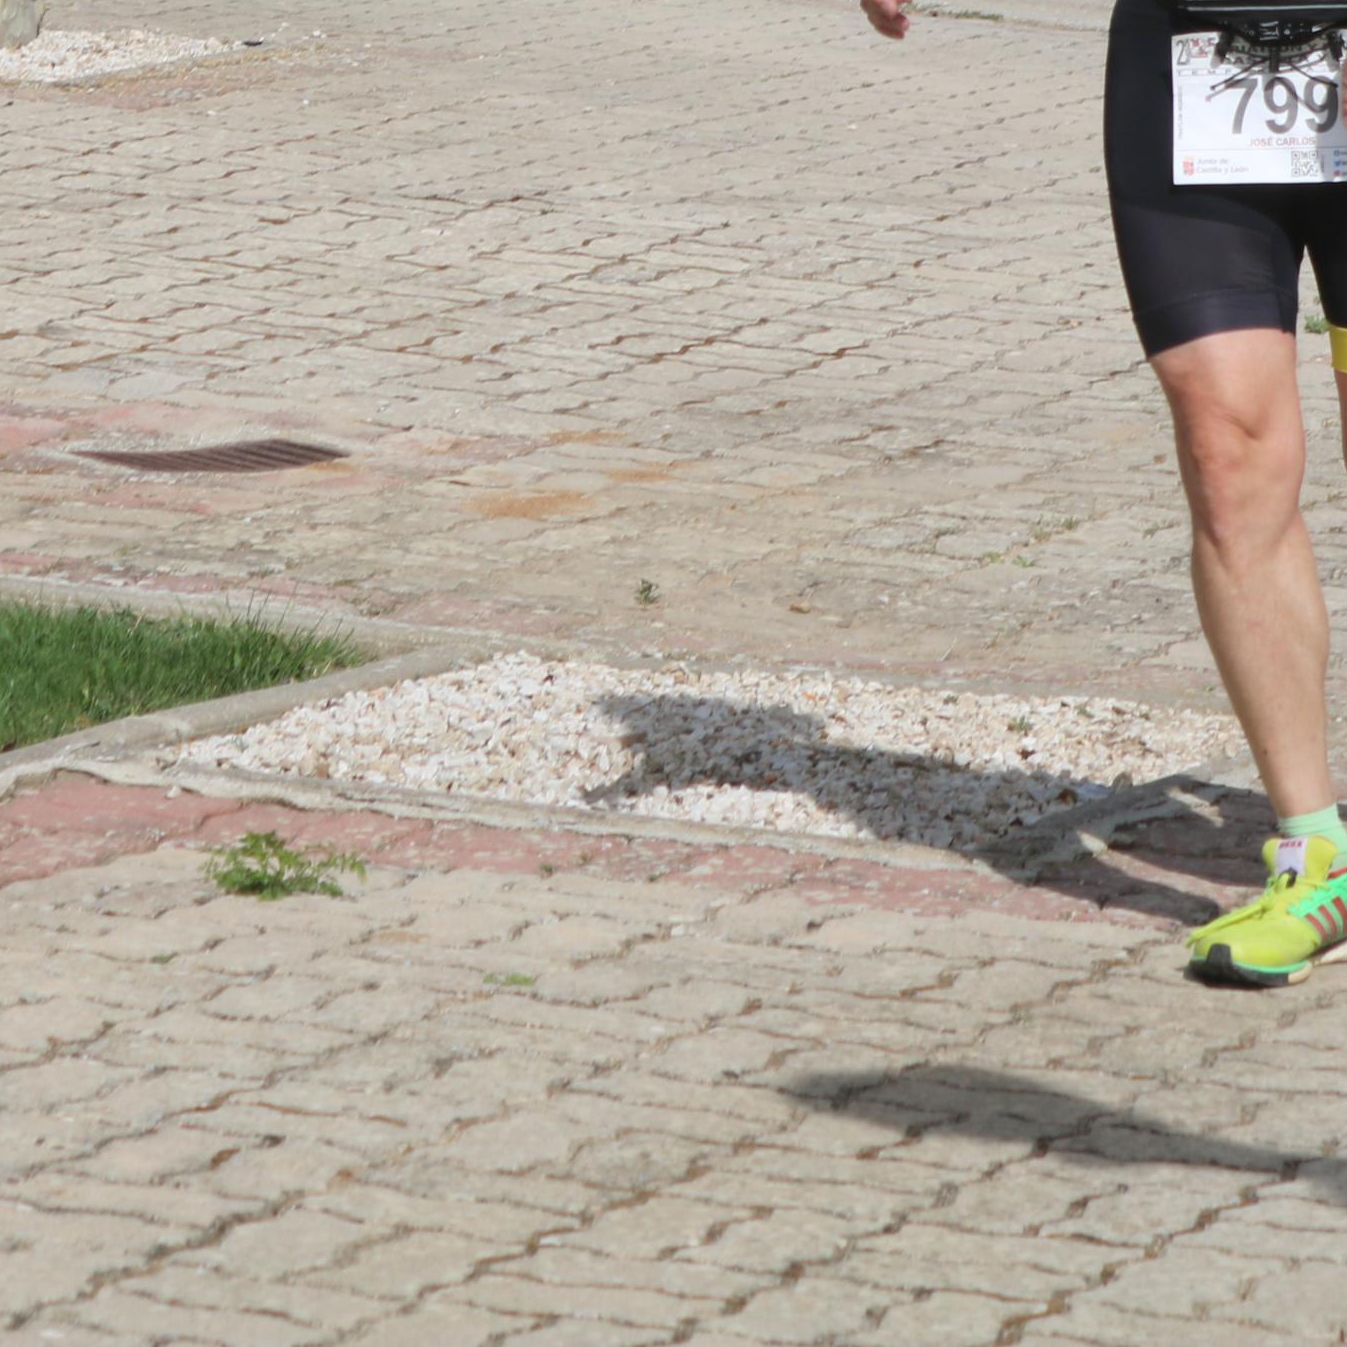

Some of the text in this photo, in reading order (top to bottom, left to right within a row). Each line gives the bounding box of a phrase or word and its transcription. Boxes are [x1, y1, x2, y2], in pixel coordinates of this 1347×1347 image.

[1224, 75, 1339, 135] 799
[1250, 137, 1316, 147] JOSÉ CARLOS
